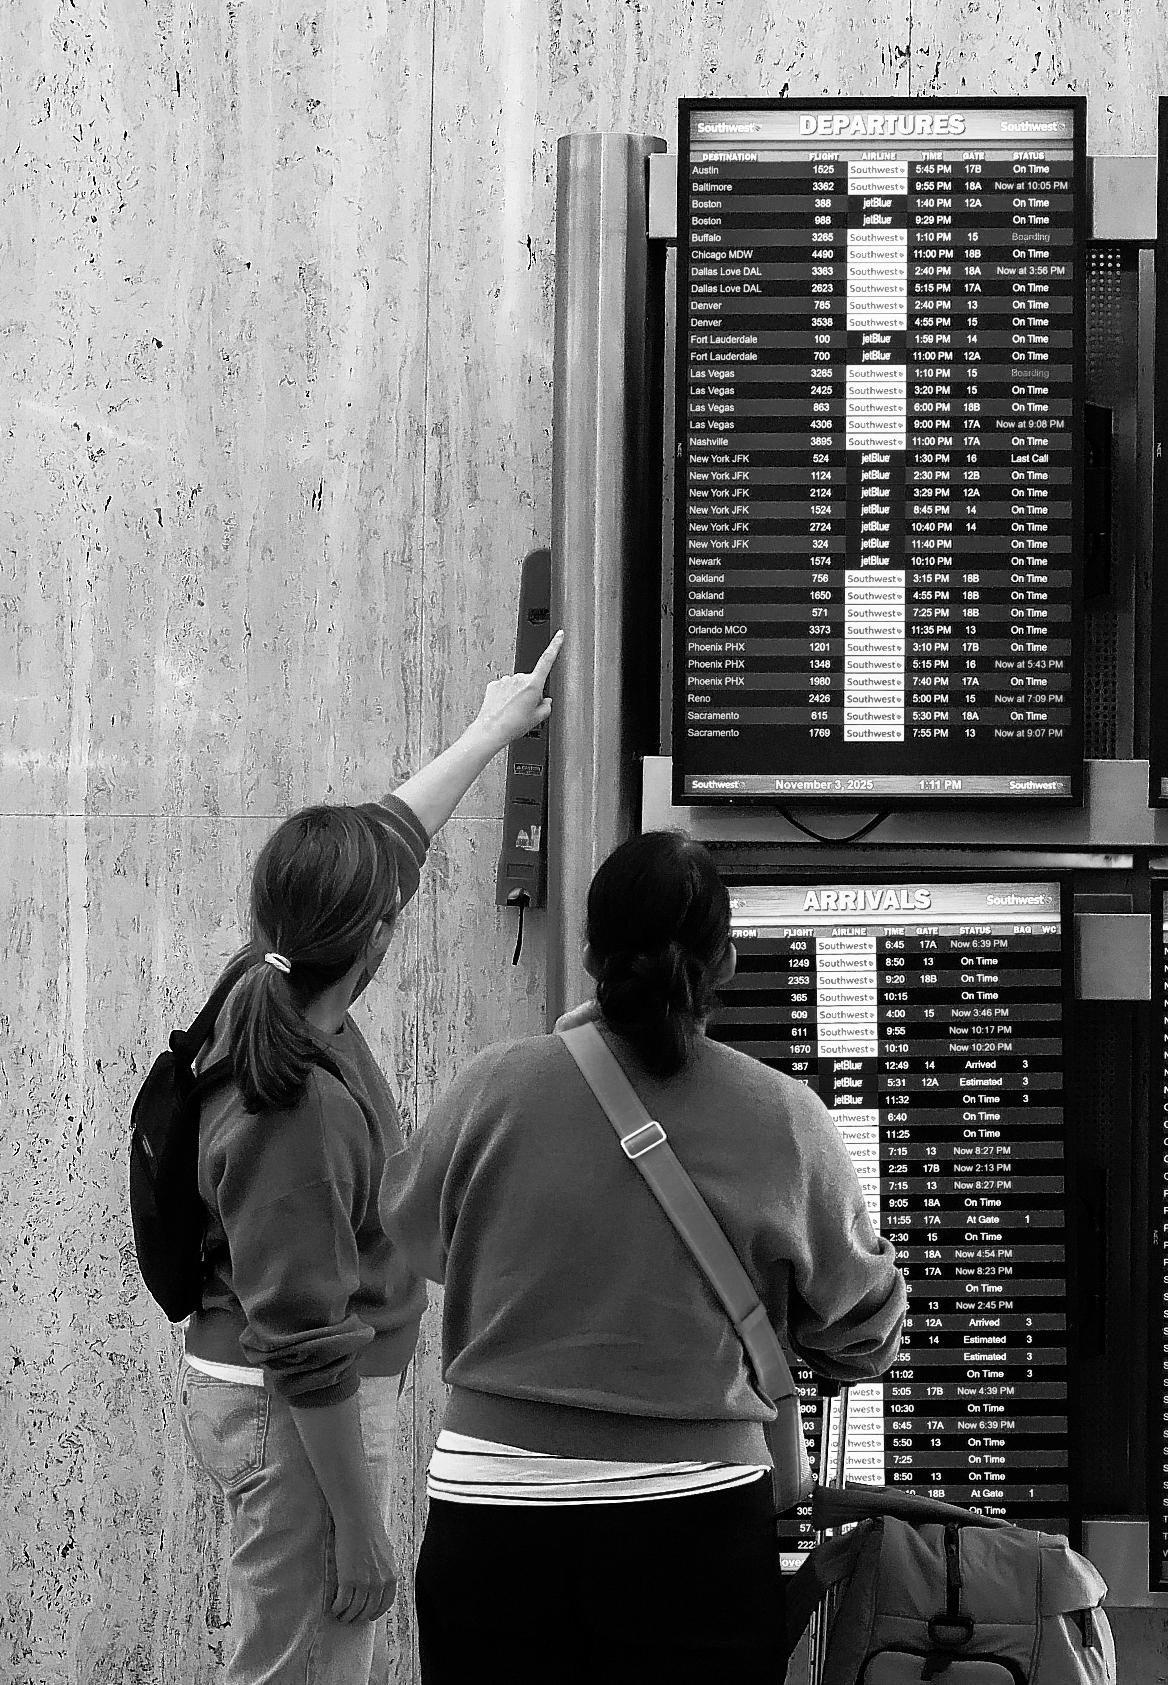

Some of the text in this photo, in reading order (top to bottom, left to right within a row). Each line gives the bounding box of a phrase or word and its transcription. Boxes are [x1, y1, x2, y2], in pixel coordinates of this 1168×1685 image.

[697, 113, 967, 136] Southwest DEPARTURES
[702, 152, 1044, 162] DESTINATION FLIGHT AIRLINE TIME GATE STATUS
[692, 166, 718, 174] Austin
[813, 165, 834, 173] 1525
[916, 165, 934, 173] 5:45
[937, 165, 951, 173] PM
[965, 165, 981, 173] 17B
[1013, 165, 1026, 173] On
[1028, 165, 1049, 173] Time
[692, 779, 962, 792] Southwest November 3, 2025 1:11 PM
[803, 889, 1044, 912] ARRIVALS Southwest
[789, 959, 809, 967] 1249
[819, 959, 867, 967] Southwest
[886, 958, 904, 966] 8:50
[961, 957, 974, 965] On
[976, 957, 998, 965] Time
[792, 1060, 1028, 1072] 387 jetBlue 12:49 14 Arrived 3
